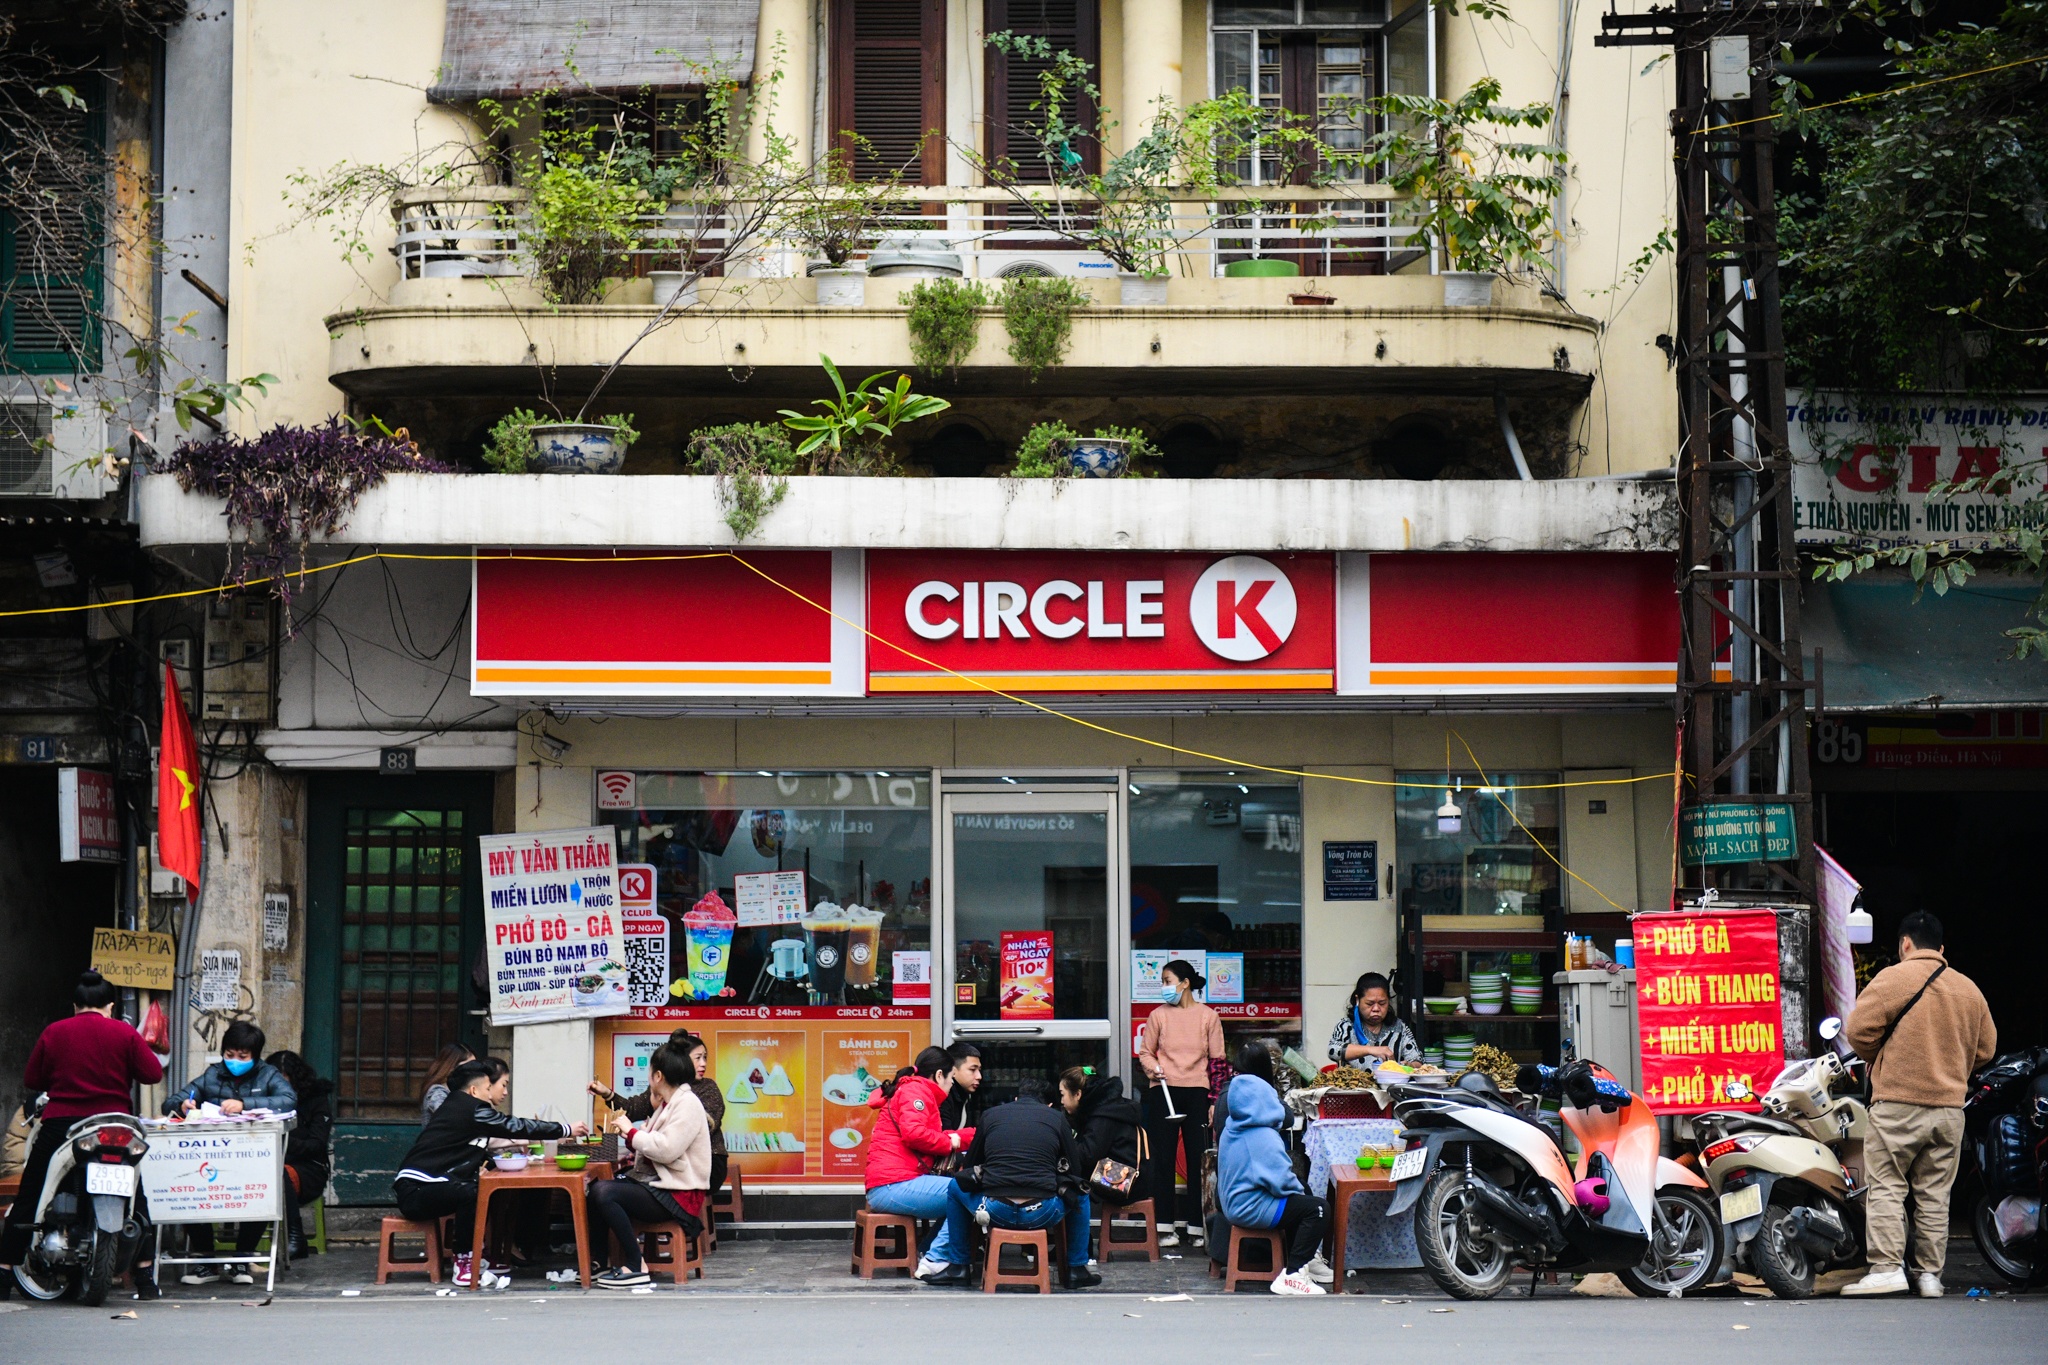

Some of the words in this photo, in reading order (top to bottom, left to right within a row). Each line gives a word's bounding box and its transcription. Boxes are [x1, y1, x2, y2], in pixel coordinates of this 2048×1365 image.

[1847, 498, 1911, 531] NGUYÊN
[1966, 504, 1997, 533] SEN
[904, 579, 1165, 640] CIRCLE
[1817, 719, 1862, 763] 85
[27, 741, 46, 758] 81
[387, 752, 408, 770] 83
[1875, 751, 1912, 765] Hàng
[1957, 751, 1978, 763] Hà
[1981, 751, 2001, 765] Nội
[1720, 808, 1749, 817] PHƯỜNG
[1716, 820, 1742, 836] ĐƯỜNG
[1727, 840, 1758, 856] SẠCH
[1768, 838, 1790, 853] ĐẸP
[489, 845, 515, 876] MỲ
[521, 839, 559, 873] VẰN
[562, 835, 612, 869] THẮN
[583, 873, 611, 890] TRỘN
[491, 882, 527, 909] MIẾN
[532, 884, 567, 905] LƯƠN
[584, 894, 613, 908] NƯỚC
[627, 909, 653, 917] CLUB
[495, 914, 535, 945] PHỞ
[541, 914, 567, 941] BÒ
[587, 910, 614, 937] GÀ
[95, 931, 117, 951] TRÀ
[117, 932, 138, 951] ĐÁ
[147, 935, 171, 955] BIA
[1653, 918, 1696, 955] PHỞ
[1702, 919, 1730, 955] GÀ
[505, 947, 532, 966] BÚN
[536, 944, 553, 963] BÒ
[557, 944, 587, 961] NAM
[591, 940, 608, 961] BỘ
[1020, 948, 1051, 959] NGAY
[222, 953, 239, 971] NHÀ
[1019, 961, 1044, 975] 10K
[517, 966, 546, 979] THANG
[518, 980, 541, 993] LƯƠN
[1657, 970, 1702, 1005] BÚN
[1705, 973, 1776, 1004] THANG
[664, 1009, 690, 1017] 24hrs
[725, 1008, 757, 1017] CIRCLE
[776, 1009, 802, 1017] 24hrs
[837, 1008, 868, 1017] CIRCLE
[887, 1009, 914, 1017] 24hrs
[1264, 1006, 1290, 1014] 24hrs
[740, 1039, 759, 1047] CƠM
[760, 1037, 779, 1047] NẮM
[839, 1038, 871, 1049] BÁNH
[873, 1040, 898, 1049] BAO
[1660, 1016, 1715, 1055] MIẾN
[1720, 1021, 1776, 1054] LƯƠN
[1662, 1065, 1706, 1105] PHỞ
[178, 1140, 207, 1150] ĐẠI
[178, 1149, 201, 1160] KIẾN
[204, 1148, 233, 1159] THIẾT
[1397, 1150, 1421, 1167] 89-L1
[95, 1166, 126, 1180] 29-C1
[1391, 1162, 1423, 1180] 371.27
[91, 1178, 130, 1194] 510.22
[170, 1185, 195, 1193] XSTD
[208, 1184, 225, 1192] 997
[244, 1183, 268, 1191] 8279
[208, 1193, 231, 1201] XSTD
[1285, 1279, 1311, 1294] BOSTON
